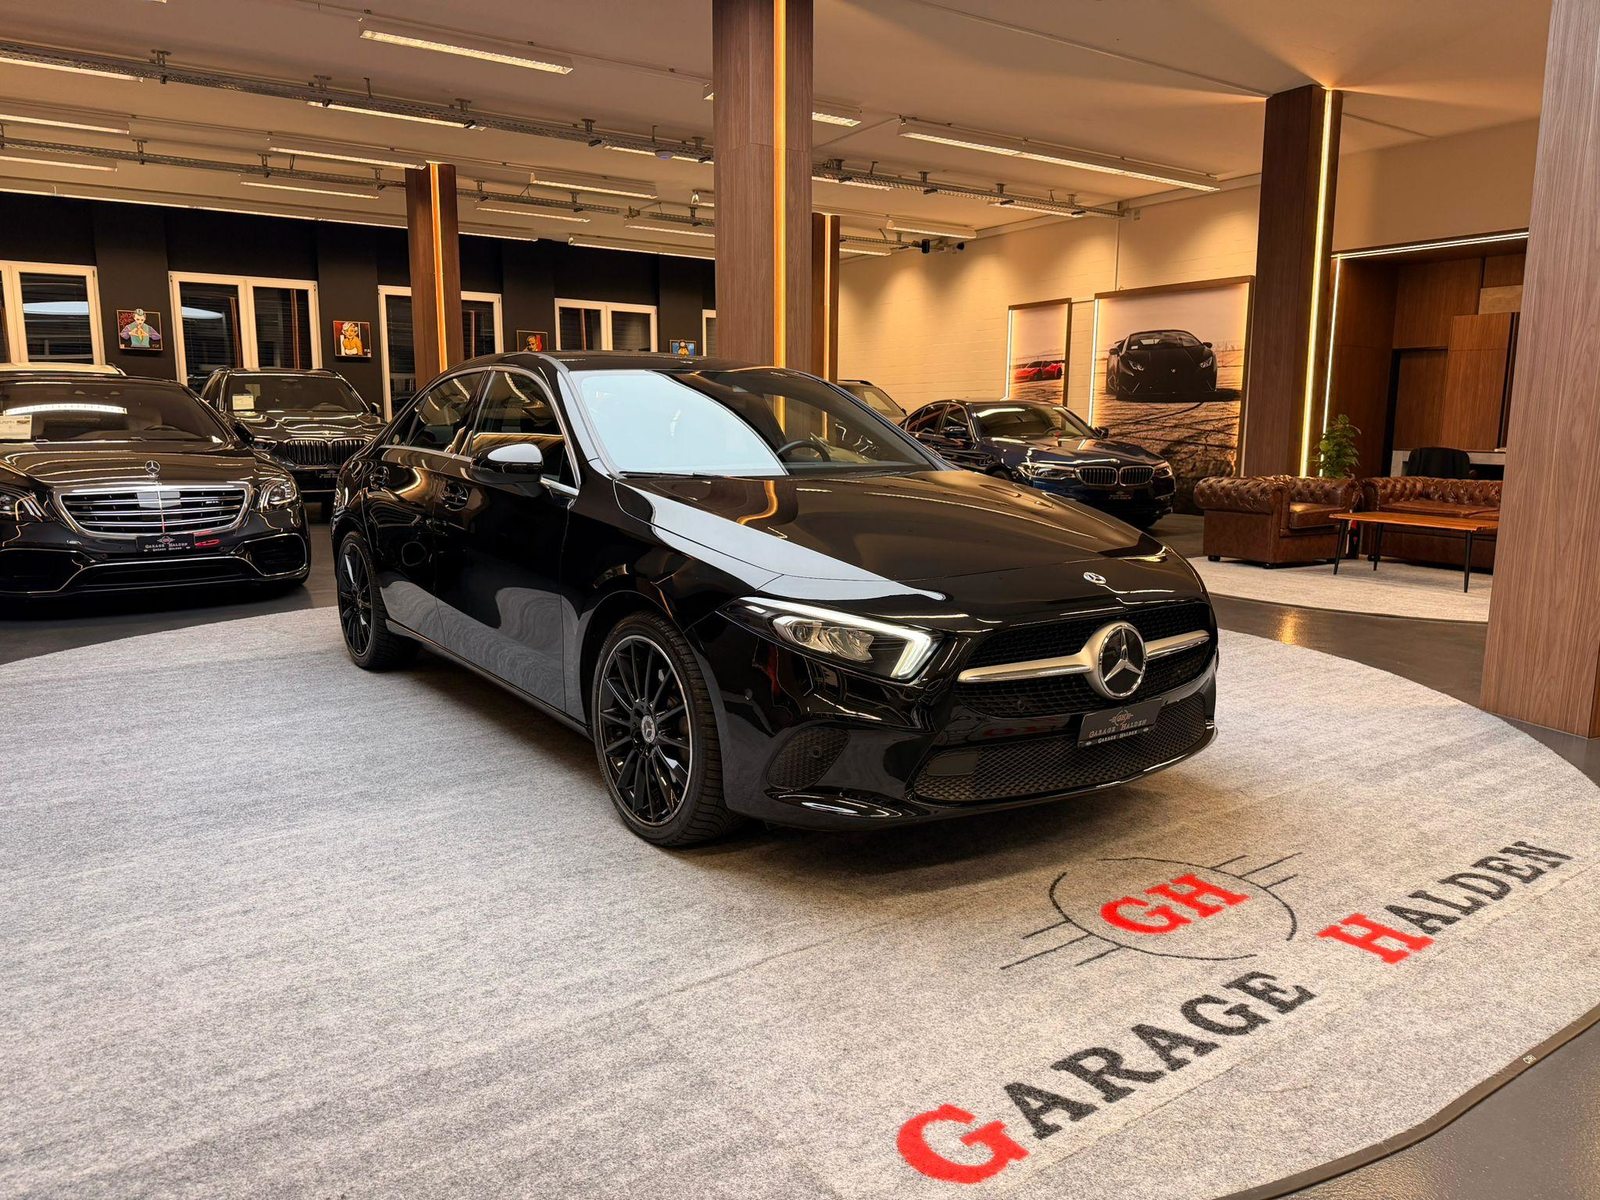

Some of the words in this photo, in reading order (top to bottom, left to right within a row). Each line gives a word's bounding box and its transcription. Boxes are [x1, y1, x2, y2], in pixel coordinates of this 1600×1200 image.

[1089, 726, 1116, 739] GARAGE
[1120, 719, 1147, 731] HALDEN
[1100, 874, 1249, 935] GH
[896, 970, 1317, 1185] GARAGE
[1316, 840, 1574, 965] HALDEN
